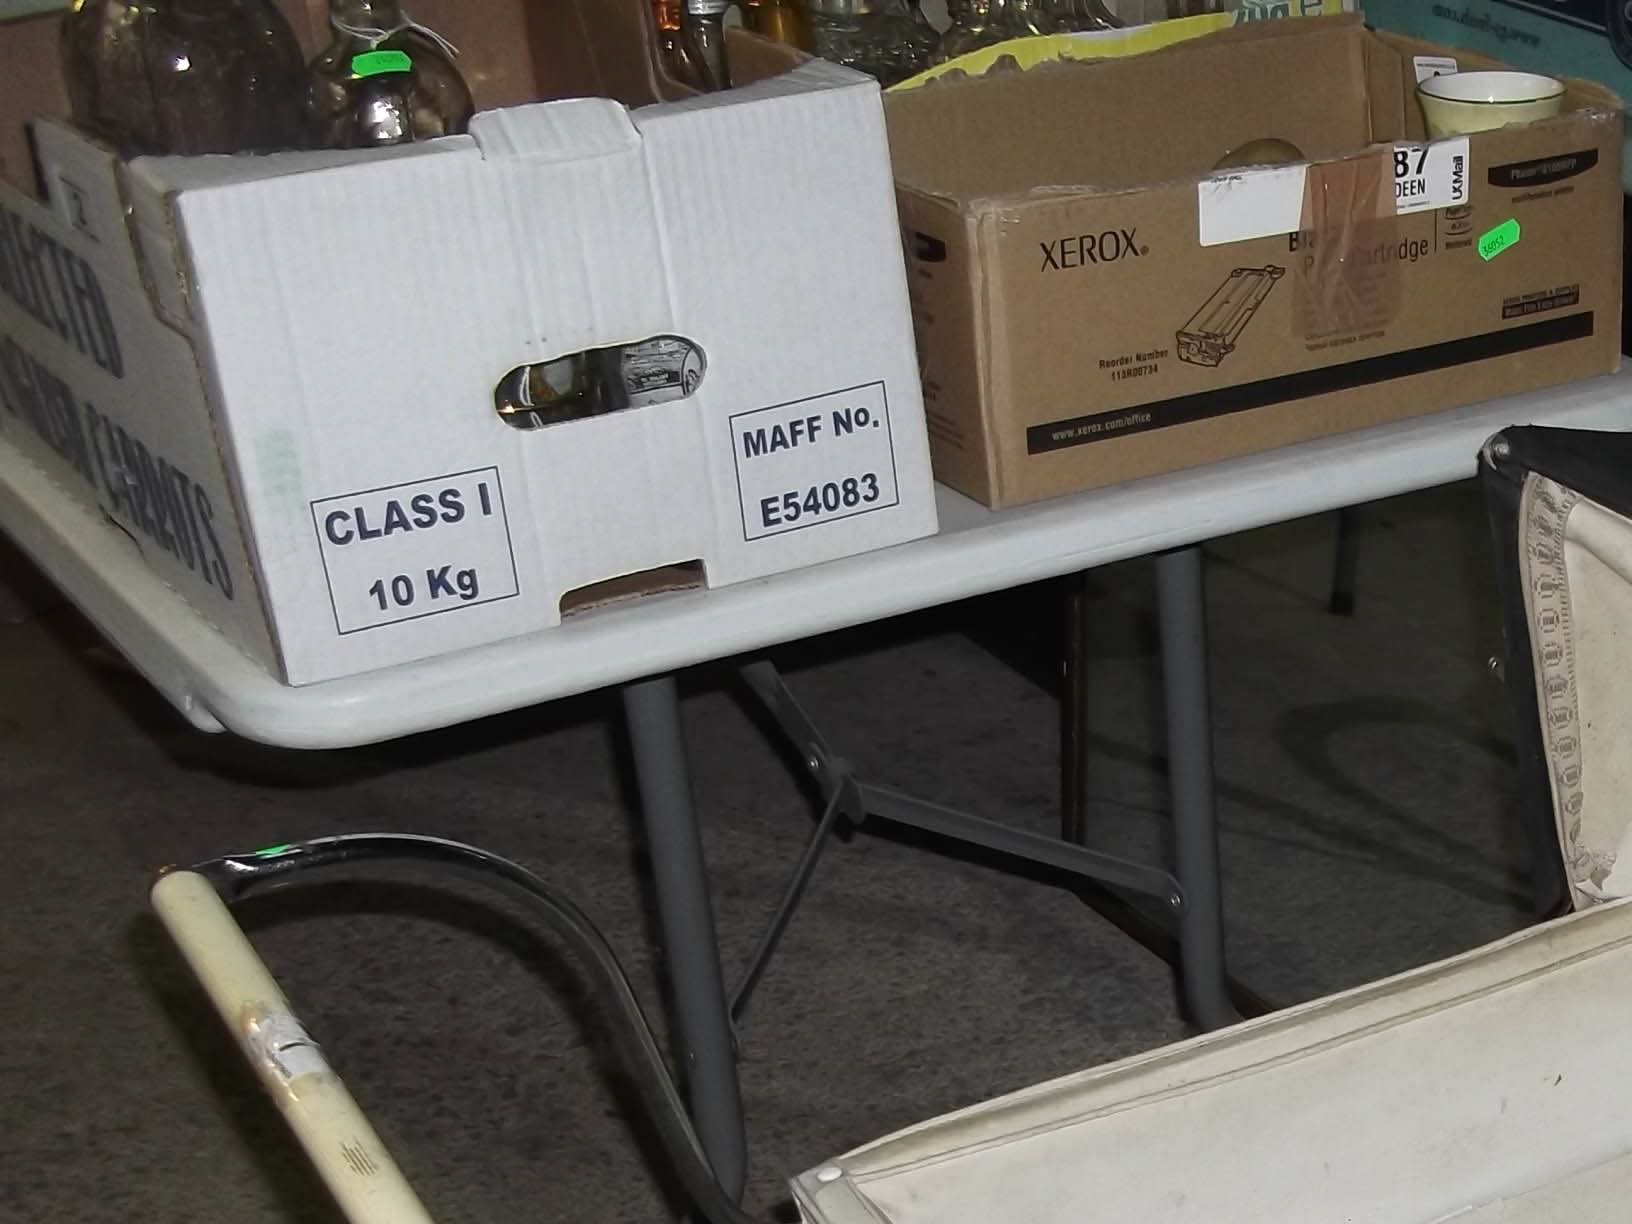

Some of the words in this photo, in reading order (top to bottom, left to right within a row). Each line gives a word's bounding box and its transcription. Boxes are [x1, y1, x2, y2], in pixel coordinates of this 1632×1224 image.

[1099, 355, 1133, 369] Reorder
[1136, 349, 1169, 362] Number
[743, 415, 822, 459] MAFF
[832, 407, 879, 437] No.
[325, 488, 465, 545] CLASS
[477, 482, 492, 516] I
[760, 472, 880, 528] E54083
[369, 574, 415, 611] 10
[426, 565, 479, 601] Kg
